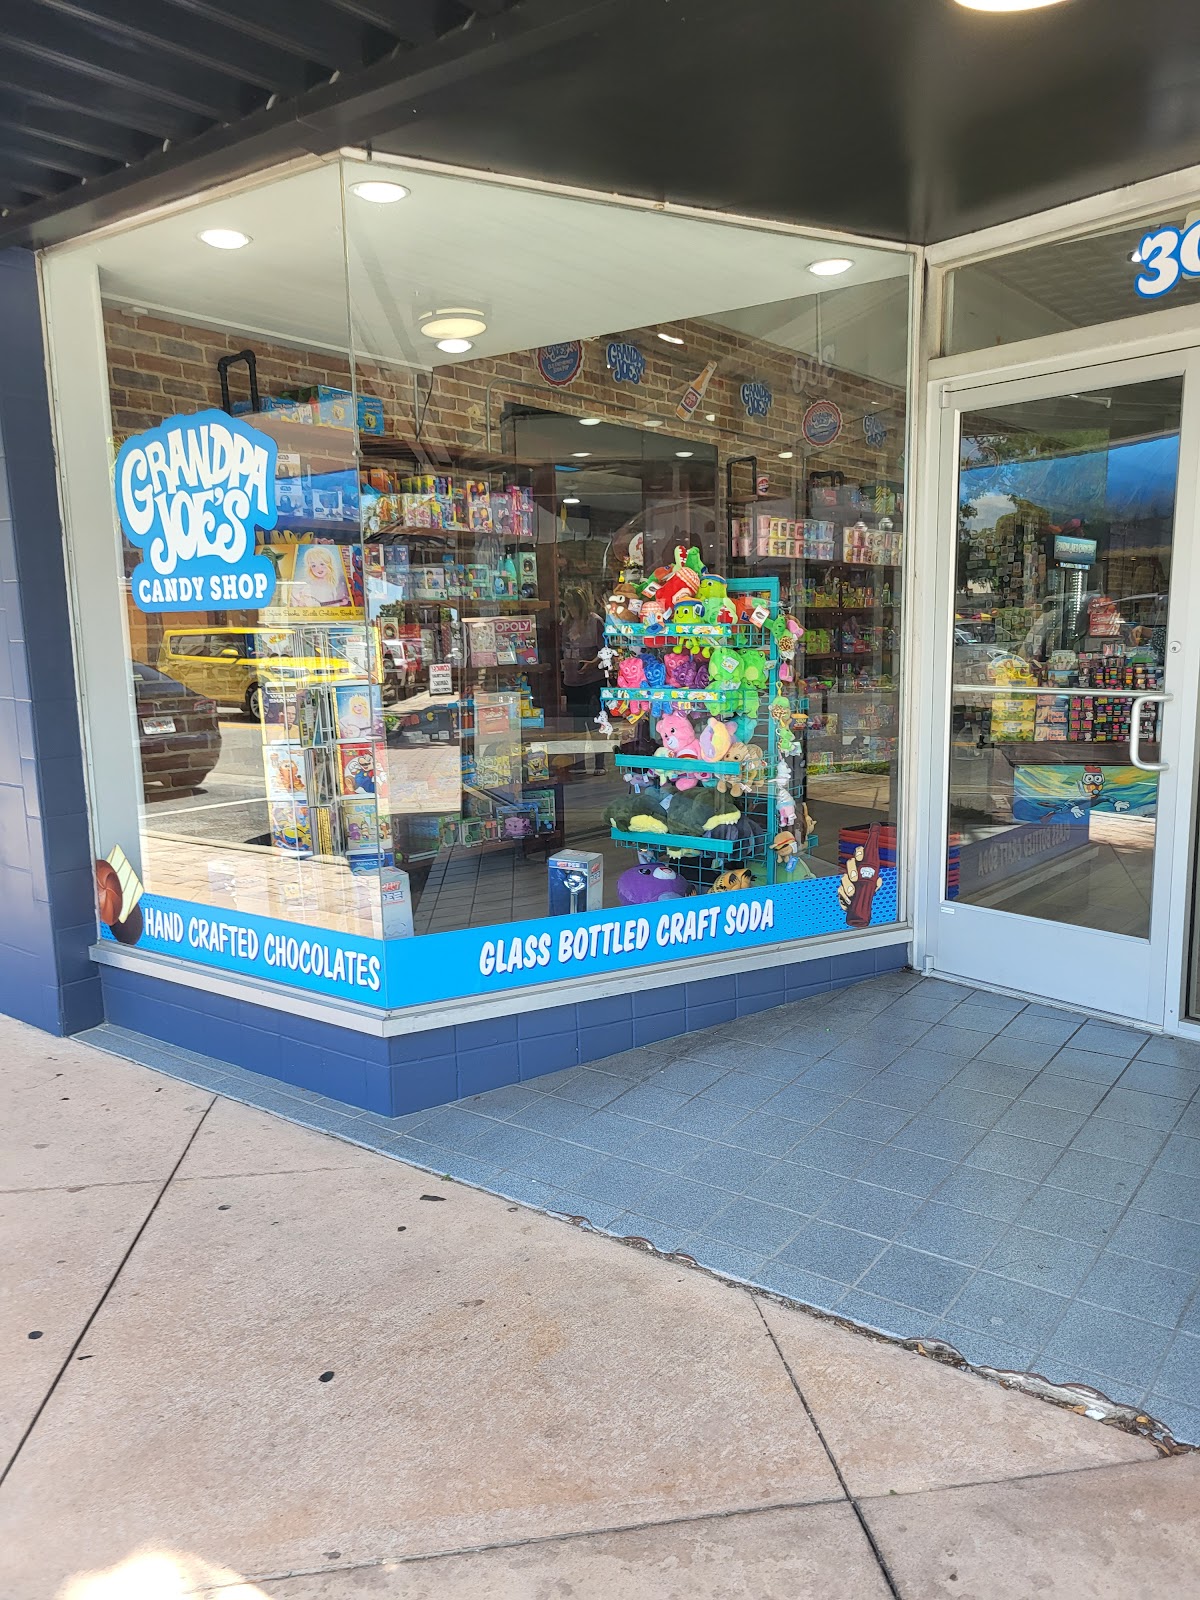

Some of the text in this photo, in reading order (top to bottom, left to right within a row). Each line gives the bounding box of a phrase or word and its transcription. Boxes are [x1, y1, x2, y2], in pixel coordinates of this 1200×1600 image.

[121, 423, 269, 535] GRANDPA
[150, 487, 250, 575] JOE'S
[138, 573, 268, 603] CANDY SHOP
[495, 620, 530, 633] OPOLY
[144, 907, 382, 991] HAND CRAFTED CHOCOLATES
[478, 899, 774, 976] GLASS BOTTLED CRAFT SODA
